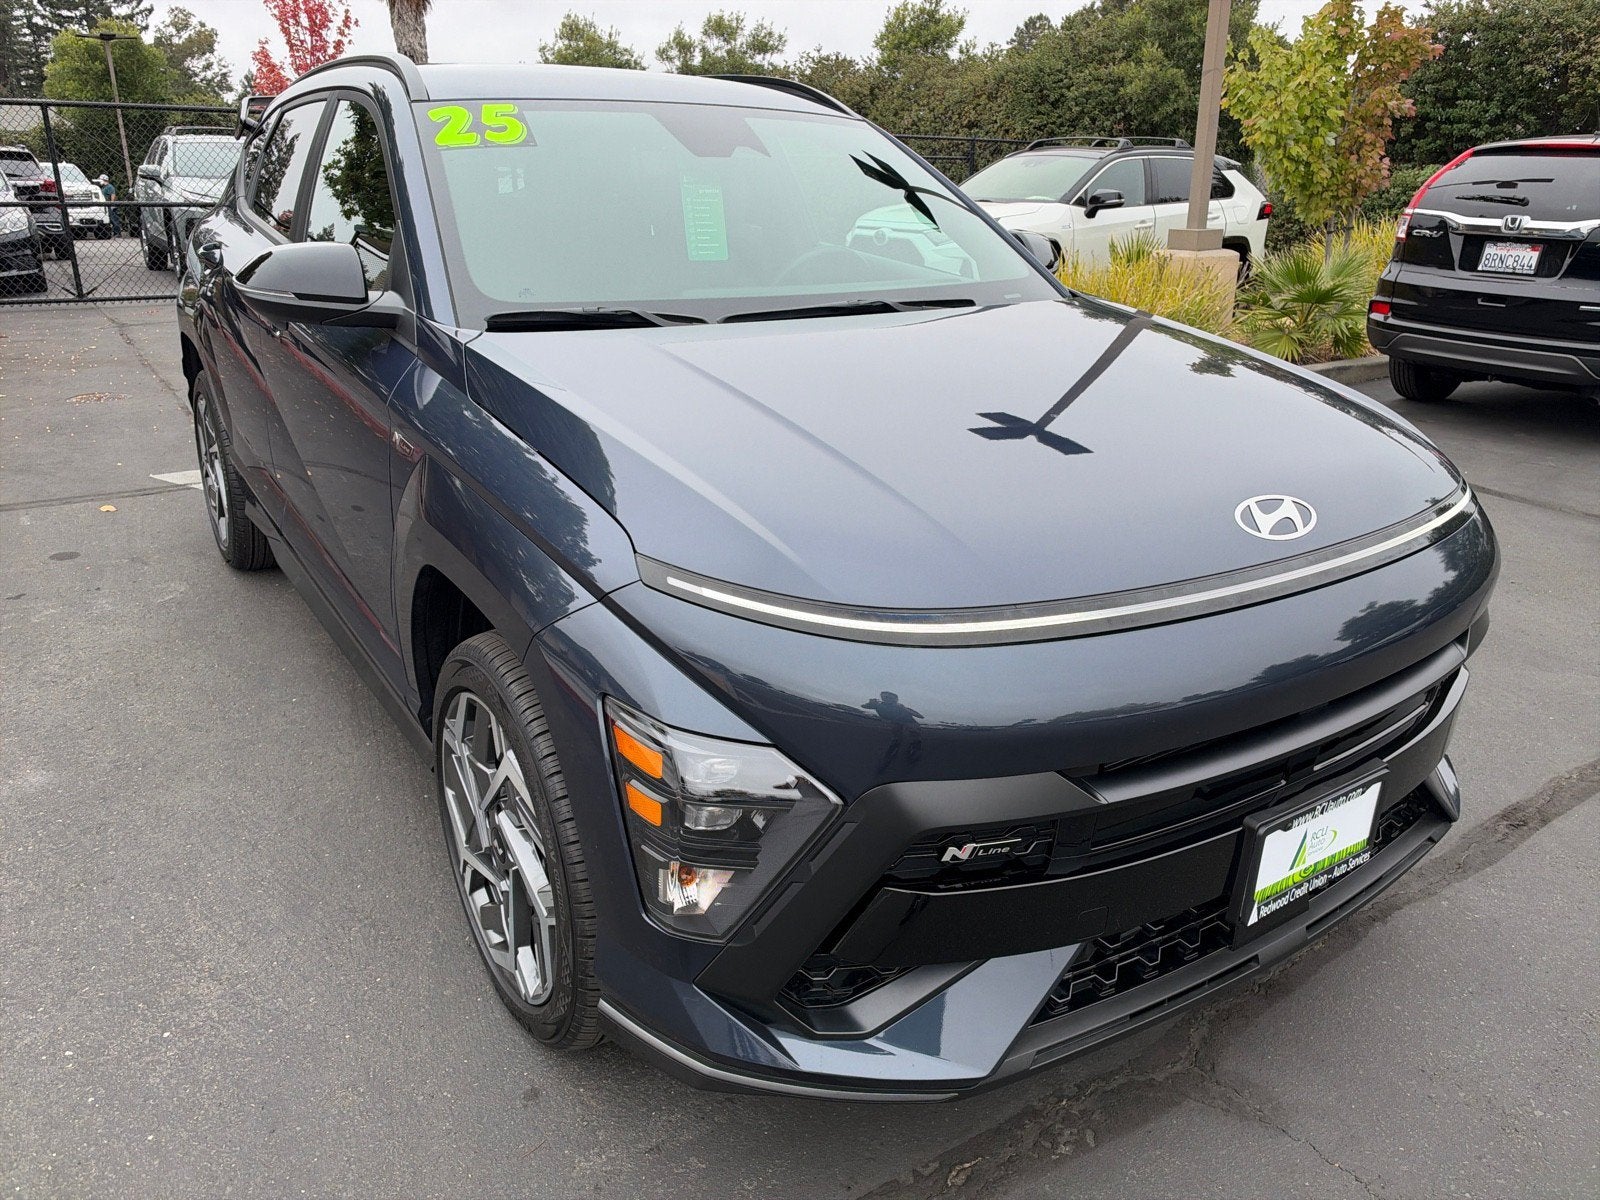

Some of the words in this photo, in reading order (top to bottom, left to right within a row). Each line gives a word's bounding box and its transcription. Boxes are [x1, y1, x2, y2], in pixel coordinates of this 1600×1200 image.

[427, 103, 528, 148] 25
[1483, 252, 1534, 269] 8RNC844
[978, 846, 1011, 856] Line
[1259, 890, 1290, 919] Redwood
[1289, 882, 1309, 902] Credit
[1308, 873, 1328, 891] Union
[1331, 865, 1348, 879] Auto
[1346, 851, 1371, 871] Services
